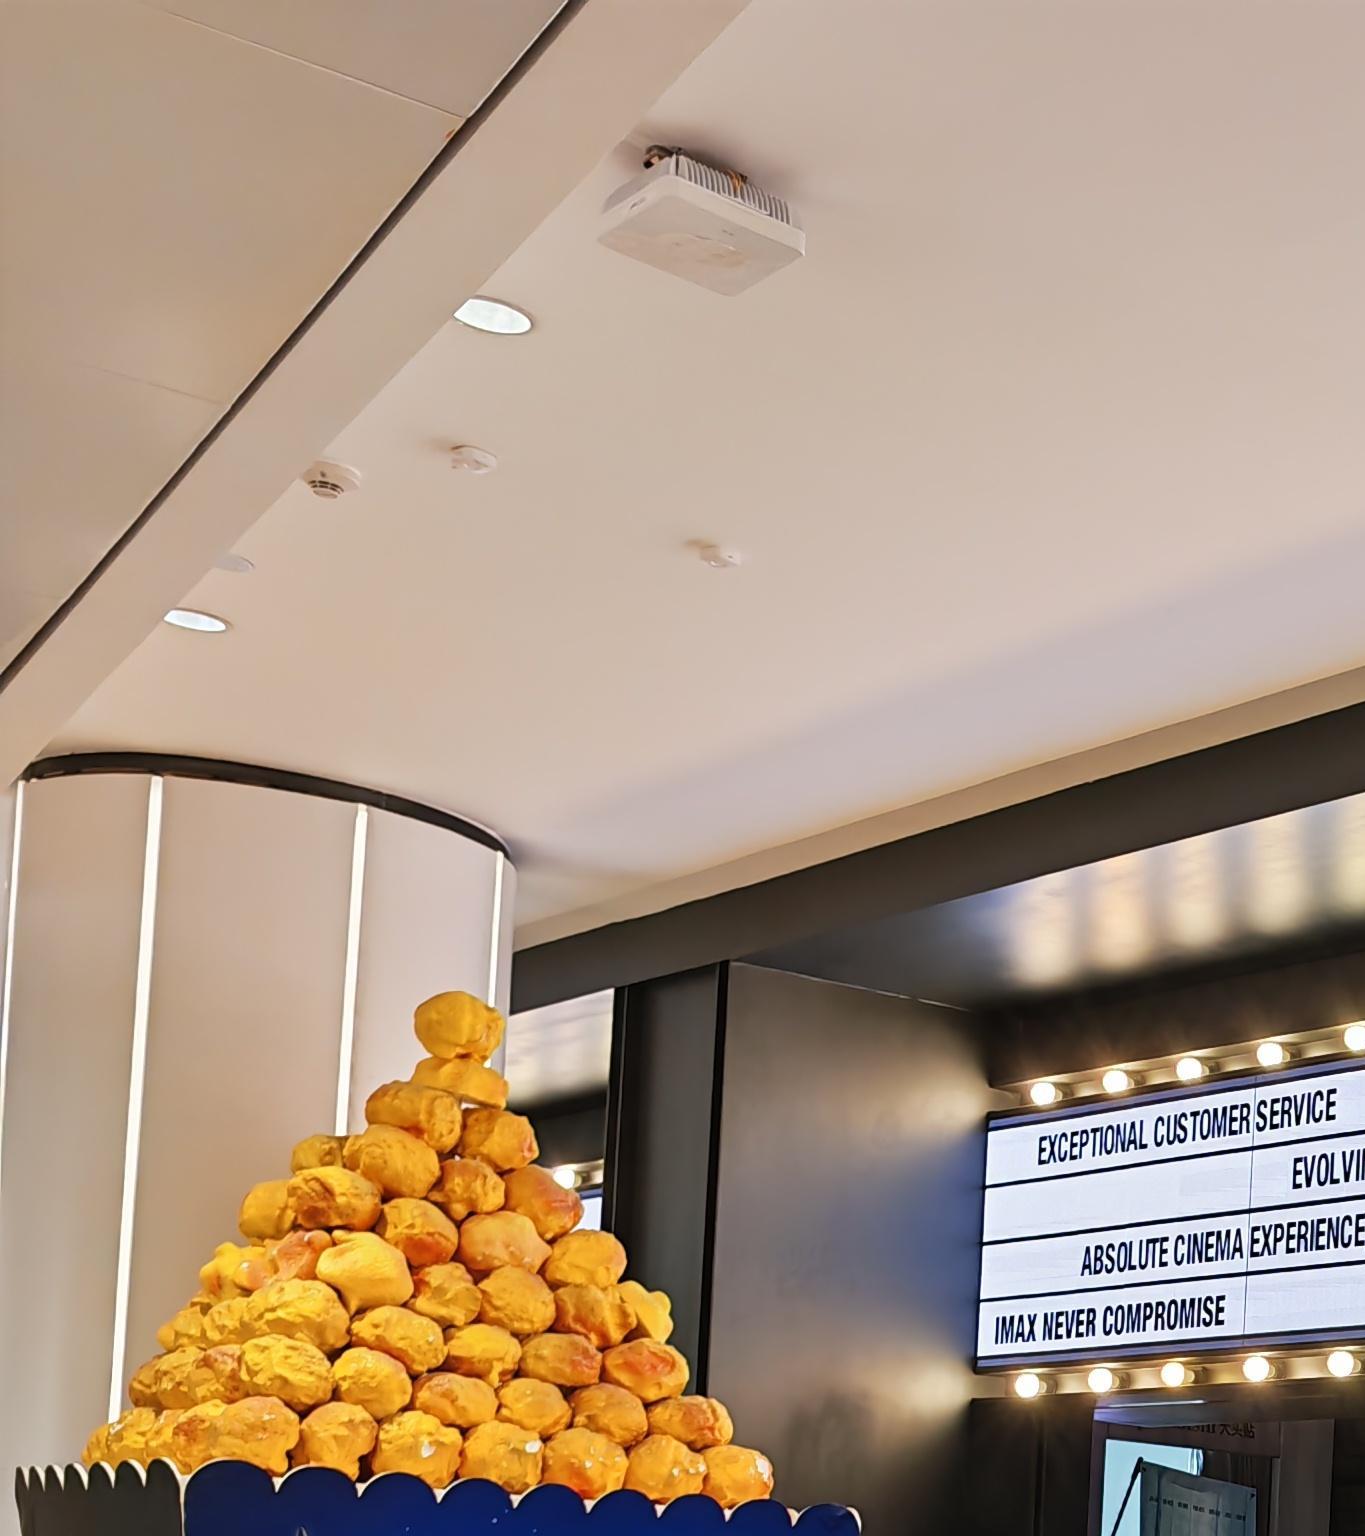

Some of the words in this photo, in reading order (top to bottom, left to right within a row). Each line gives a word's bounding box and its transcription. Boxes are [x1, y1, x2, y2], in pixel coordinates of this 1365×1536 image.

[1037, 1116, 1148, 1166] EXCEPTIONAL
[1153, 1094, 1251, 1148] CUSTOMER
[1256, 1088, 1337, 1132] SERVICE
[1081, 1237, 1170, 1277] ABSOLUTE
[1174, 1228, 1244, 1266] CINEMA
[995, 1312, 1038, 1345] IMAX
[1042, 1308, 1097, 1341] NEVER
[1102, 1295, 1226, 1337] COMPROMISE
